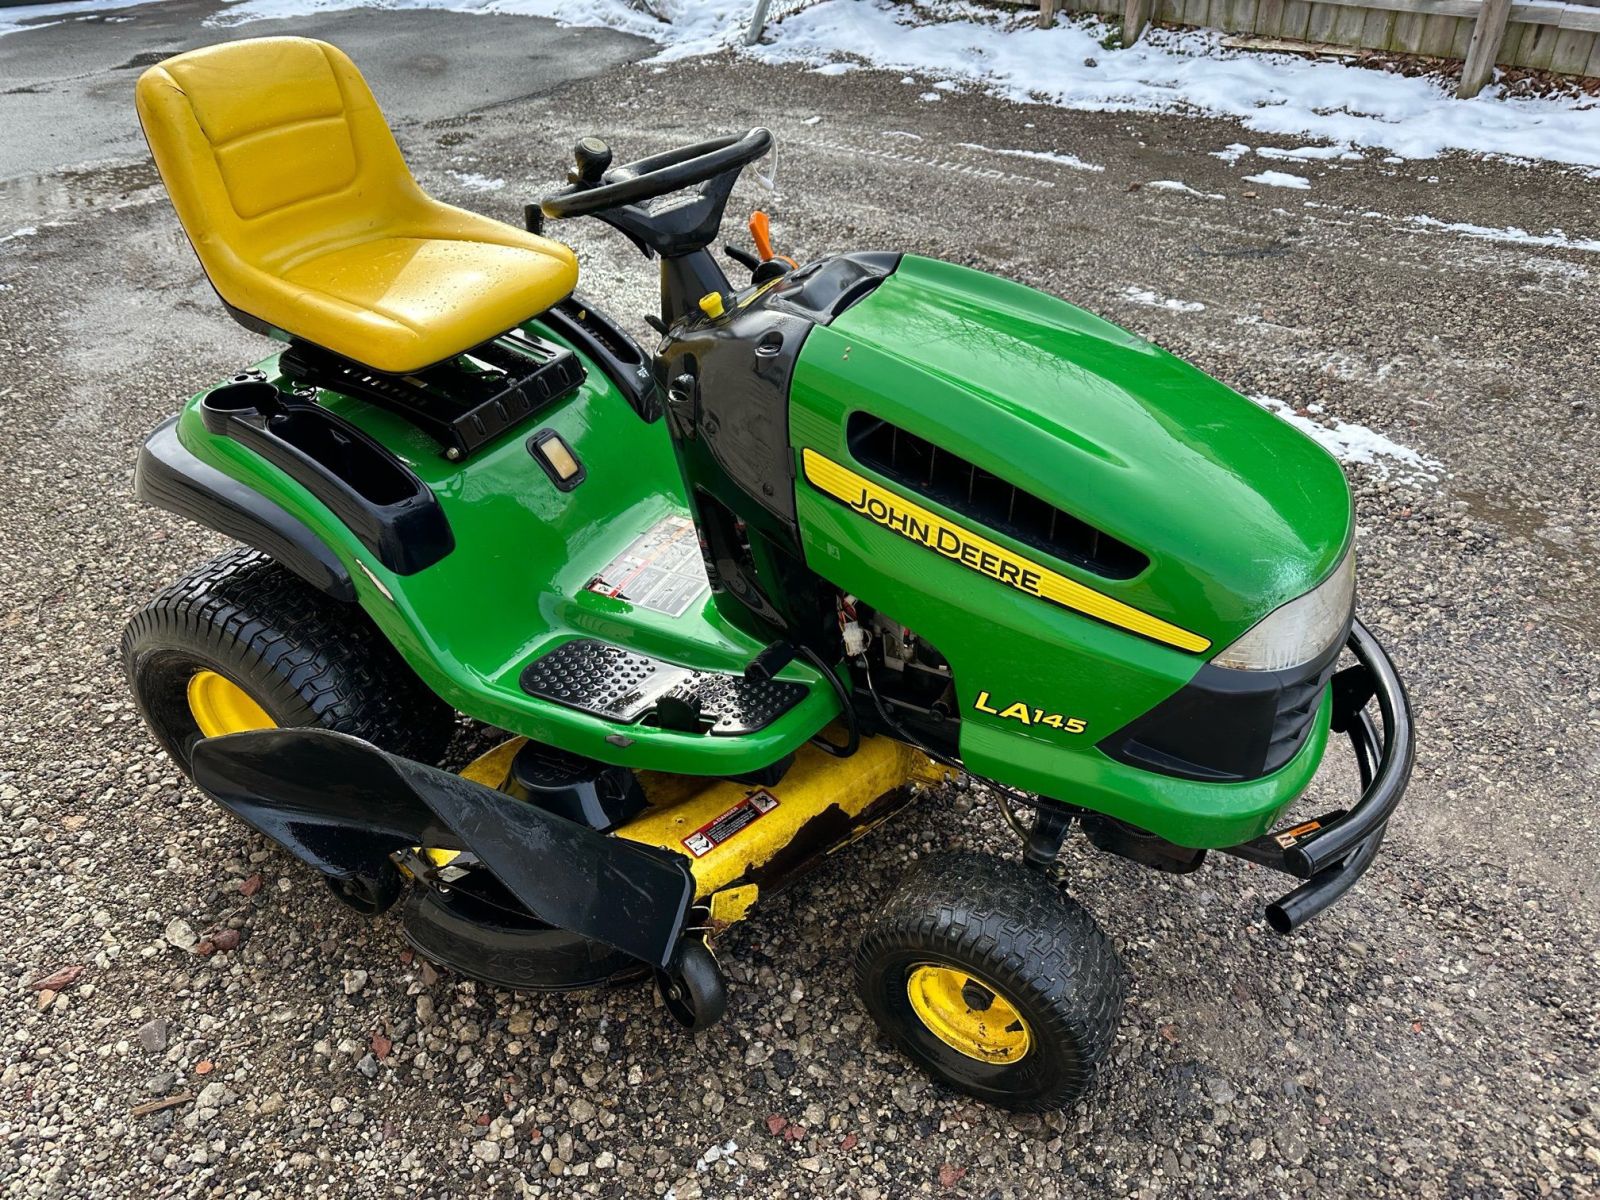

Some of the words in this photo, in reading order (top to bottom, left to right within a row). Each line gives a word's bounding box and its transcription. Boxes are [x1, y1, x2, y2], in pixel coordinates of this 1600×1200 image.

[851, 488, 930, 543] JOHN
[937, 527, 1041, 593] DEERE
[974, 690, 1088, 735] LA145
[716, 806, 739, 823] DANGER
